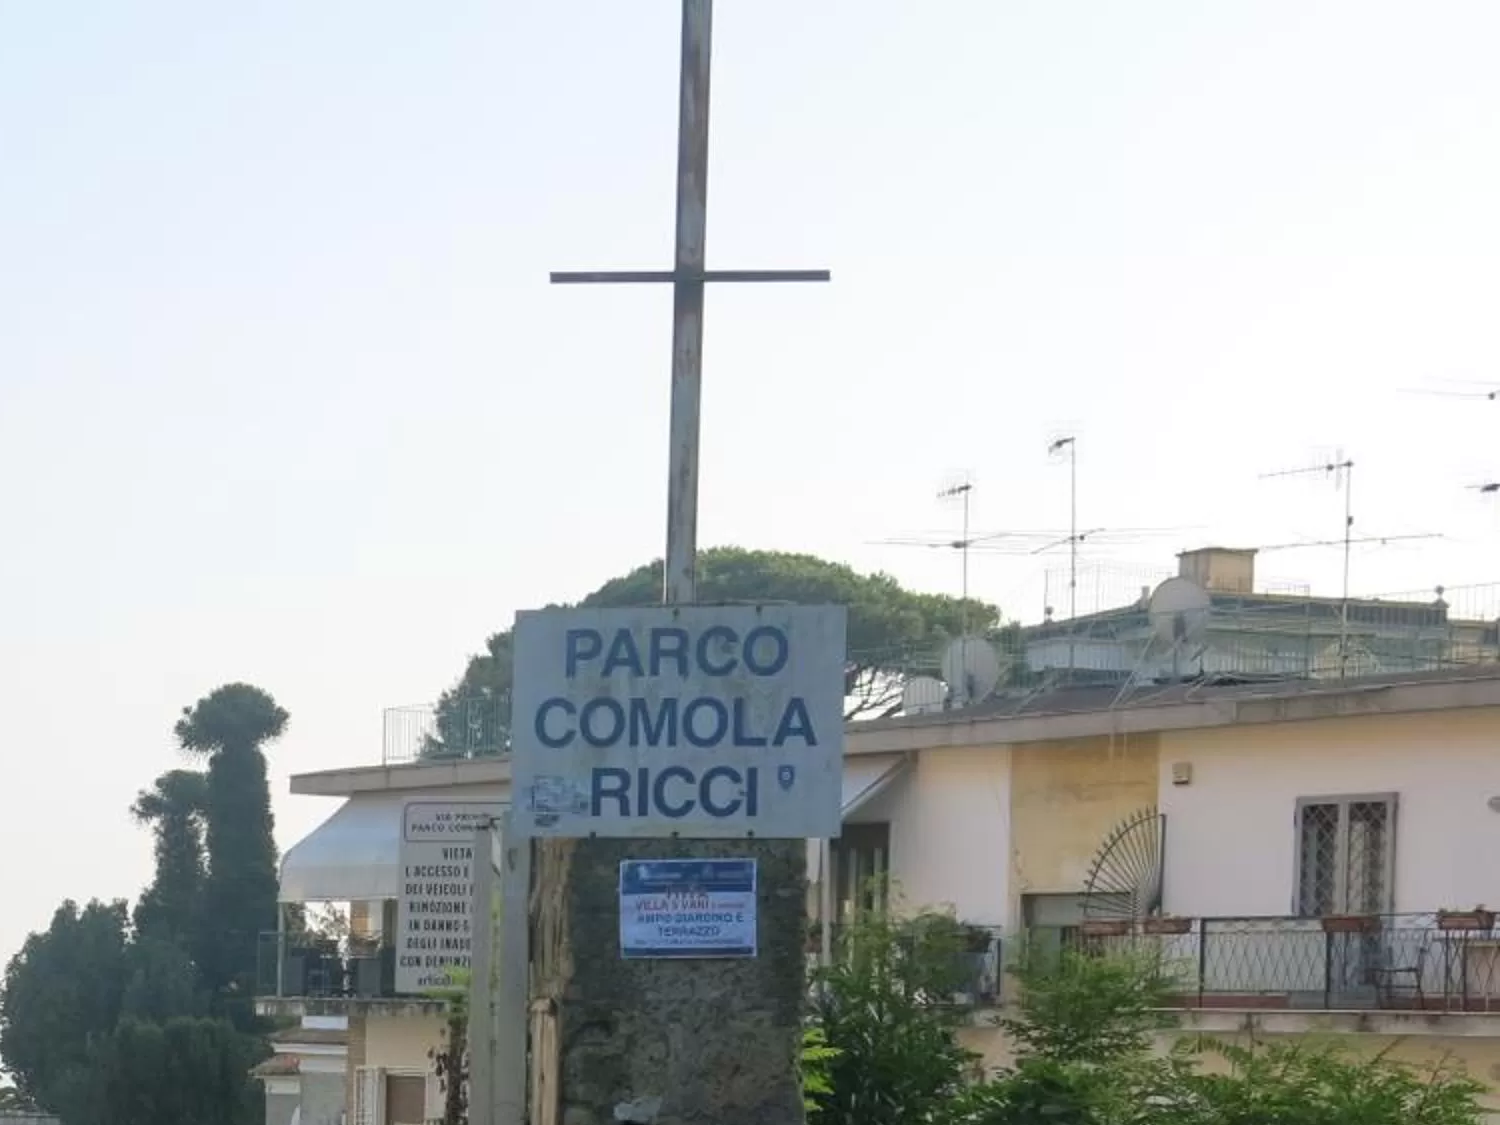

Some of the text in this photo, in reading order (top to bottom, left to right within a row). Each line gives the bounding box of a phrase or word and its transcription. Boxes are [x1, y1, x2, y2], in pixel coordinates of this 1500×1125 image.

[565, 626, 789, 678] PARCO
[534, 697, 818, 748] COMOLA
[591, 765, 758, 818] RICCI
[442, 847, 474, 861] VIETA
